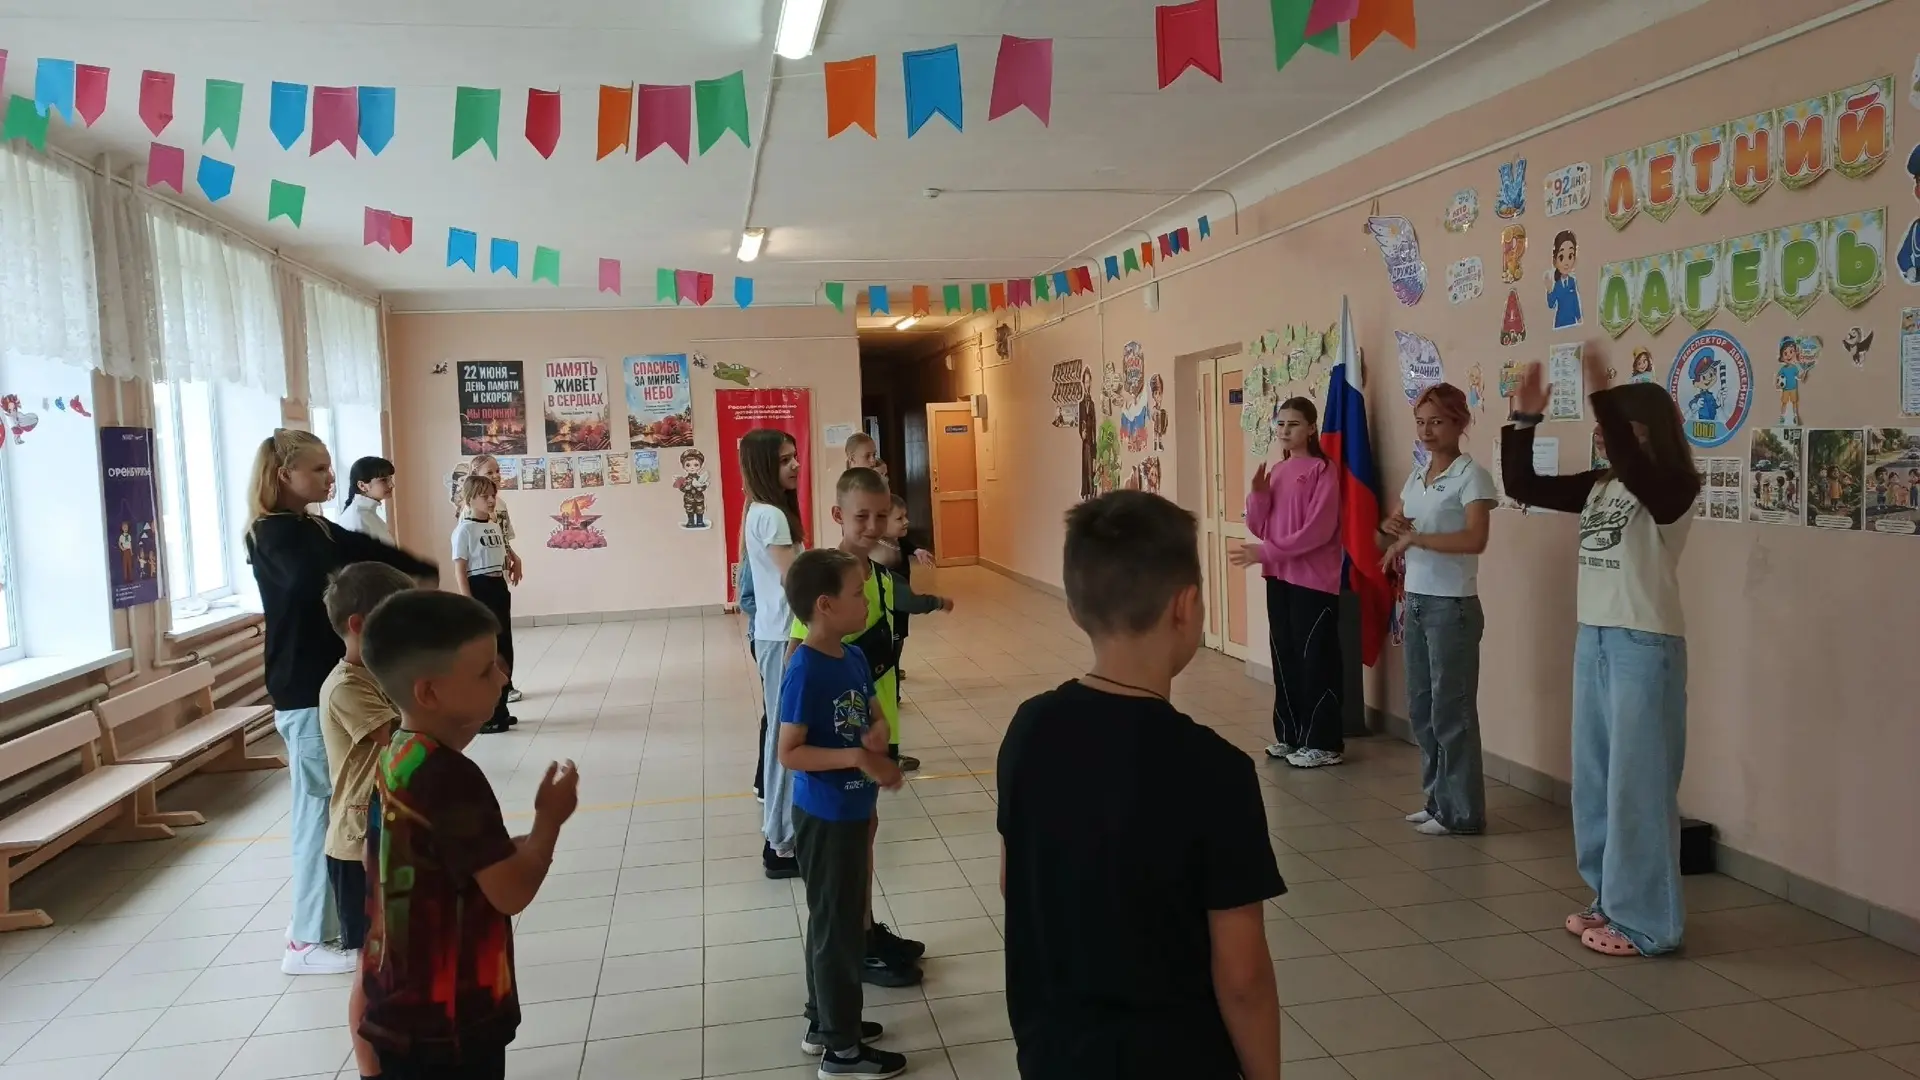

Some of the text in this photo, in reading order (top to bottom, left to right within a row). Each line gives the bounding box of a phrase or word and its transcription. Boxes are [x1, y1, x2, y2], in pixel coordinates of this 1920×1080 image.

[1608, 83, 1886, 216] ЛЕТНИЙ
[1554, 173, 1587, 197] 92 ДНЯ
[1555, 192, 1578, 210] ЛЕТА
[1392, 263, 1417, 281] ДРУЖБА
[1602, 230, 1879, 323] ЛАГЕРЬ
[463, 365, 477, 380] 22
[480, 366, 508, 379] ИЮНЯ
[546, 361, 598, 378] ПАМЯТЬ
[633, 360, 680, 375] СПАСИБО
[1409, 363, 1440, 377] ЗНАНИЯ
[1682, 336, 1727, 362] ИНСПЕКТОР
[1729, 348, 1748, 408] ДВИЖЕНИЯ
[465, 380, 519, 393] ДЕНЬ ПАМЯТИ
[554, 375, 597, 393] ЖИВЁТ
[634, 374, 681, 387] ЗА МИРНОЕ
[472, 392, 513, 403] И СКОРБИ
[548, 392, 604, 407] В СЕРДЦАХ
[644, 385, 674, 401] НЕБО
[466, 408, 481, 419] МЫ
[1693, 422, 1716, 439] ЮИД
